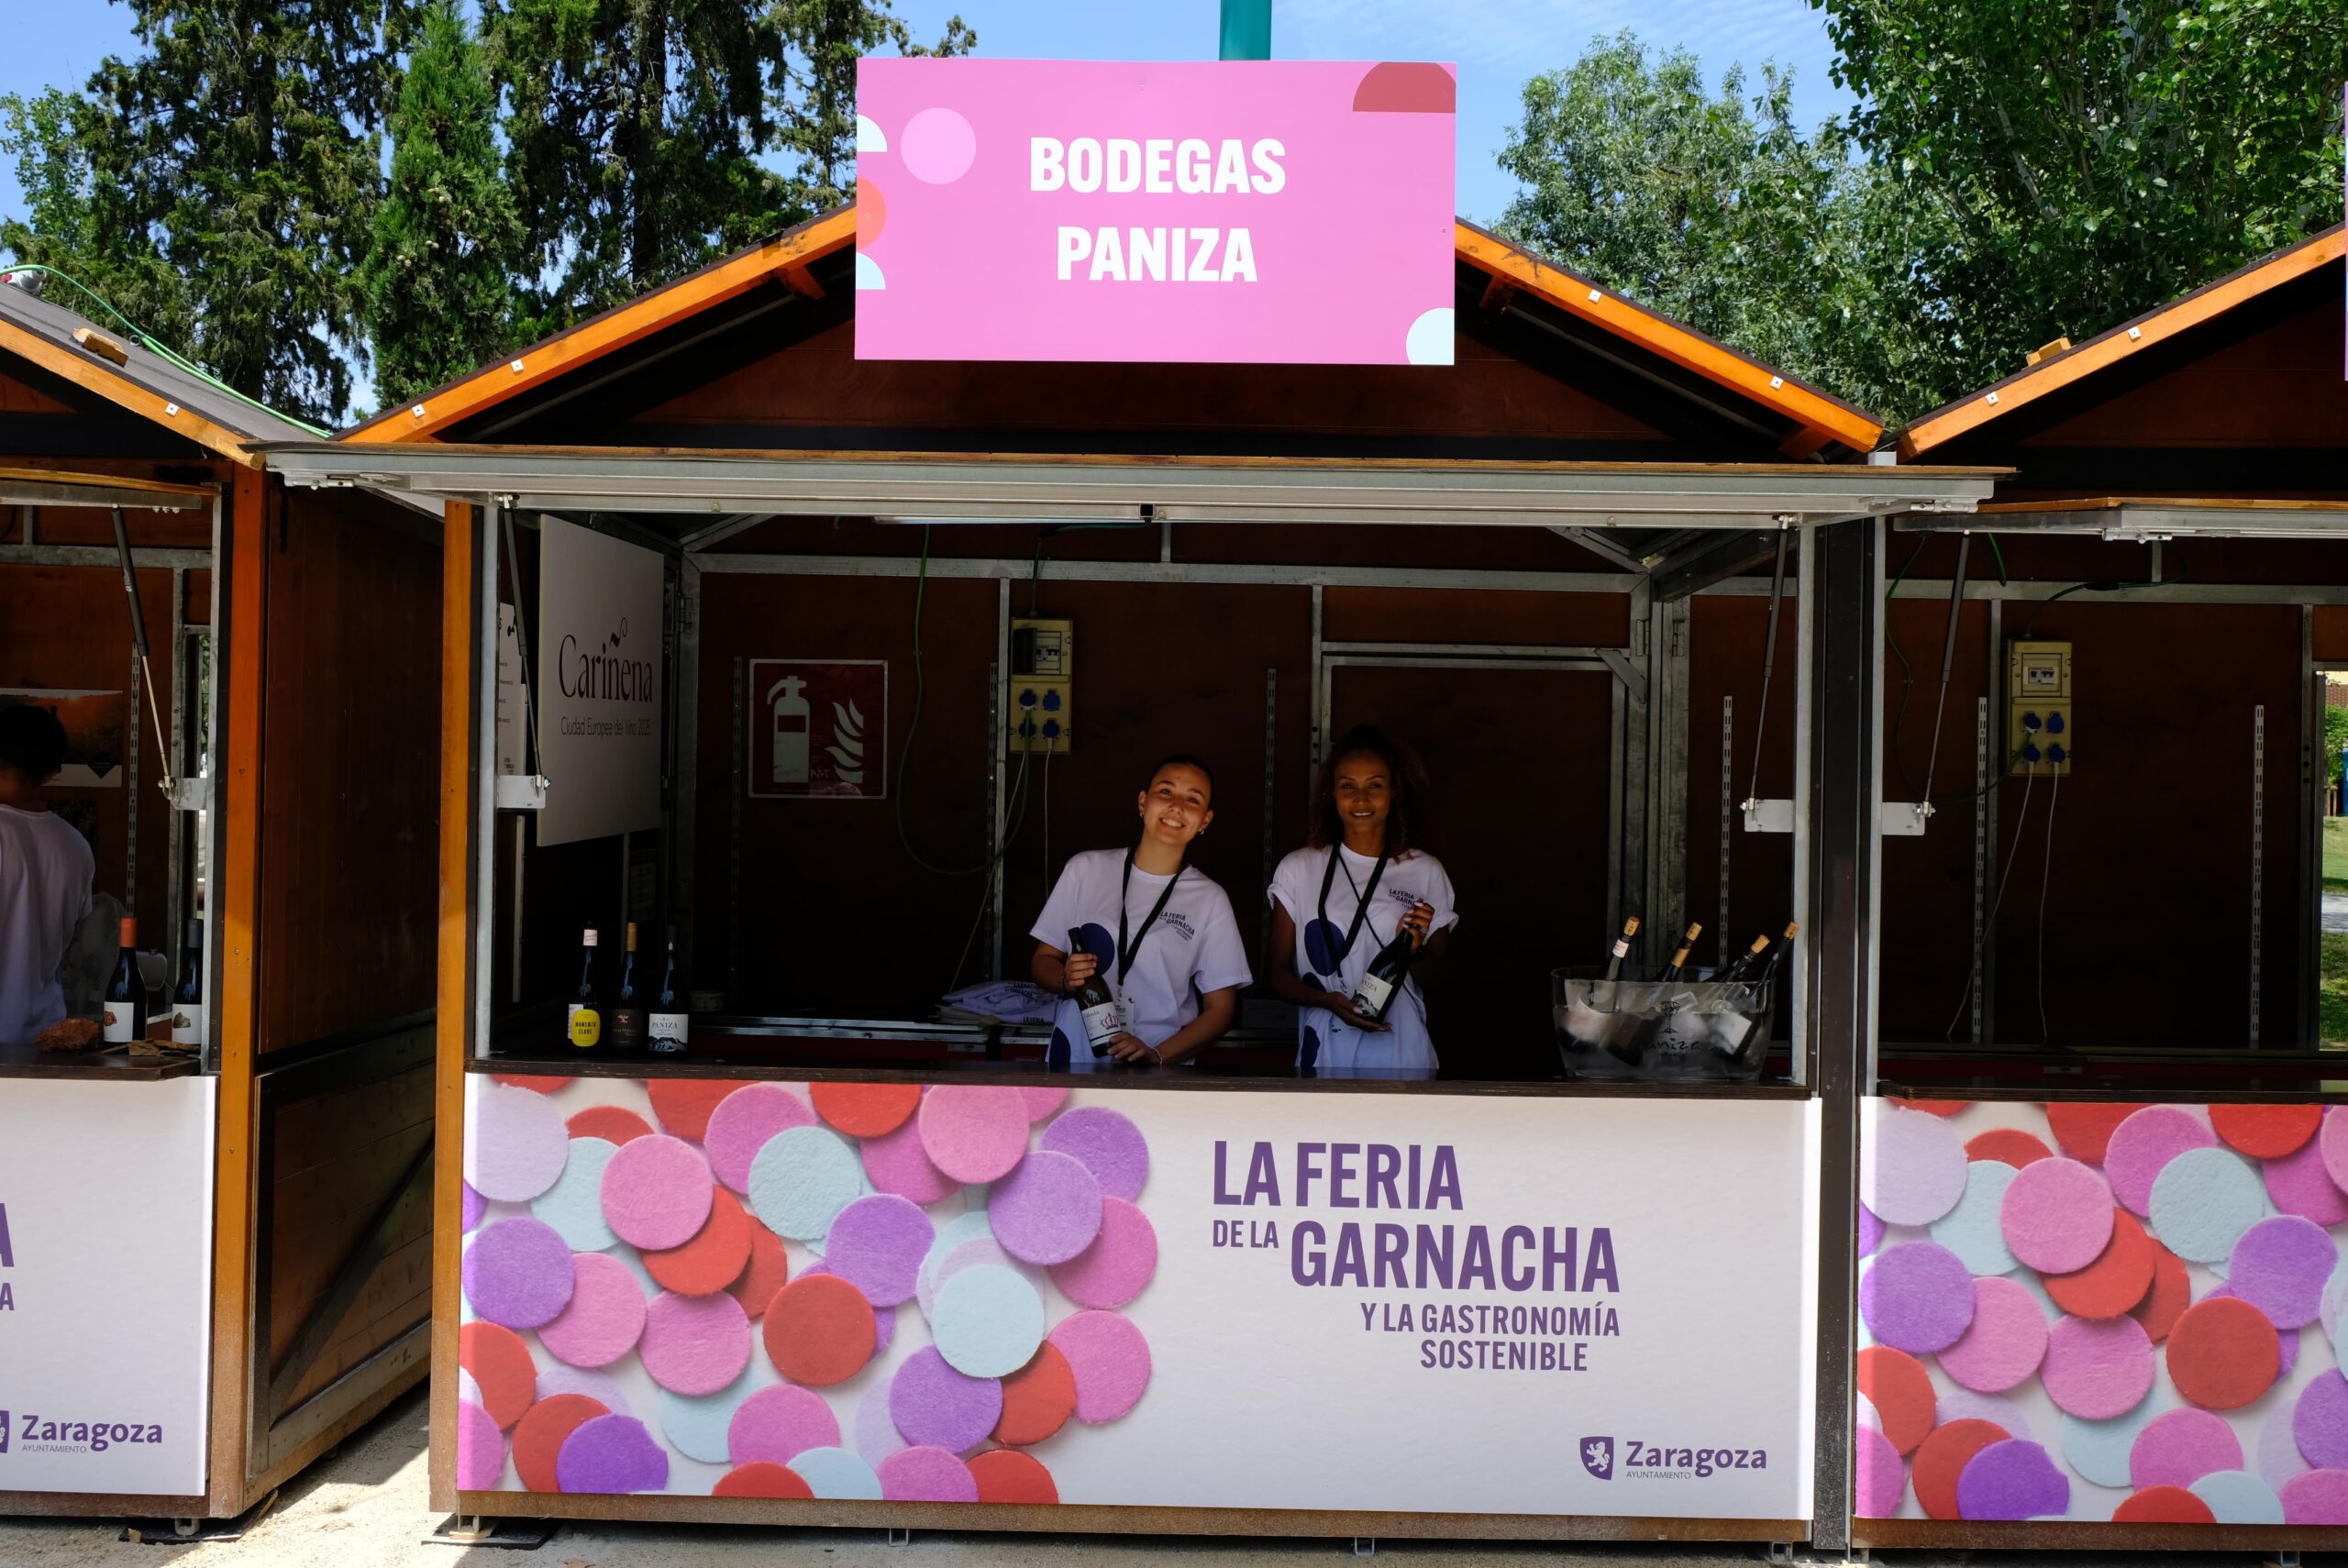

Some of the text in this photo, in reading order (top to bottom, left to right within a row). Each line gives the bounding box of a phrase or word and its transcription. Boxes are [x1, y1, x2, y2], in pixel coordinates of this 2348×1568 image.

[1030, 137, 1286, 194] BODEGAS
[1058, 226, 1258, 282] PANIZA
[559, 616, 653, 702] Cariñena
[560, 716, 585, 735] Ciudad
[587, 717, 613, 737] Europea
[614, 719, 624, 735] del
[625, 719, 637, 735] Vino
[1213, 1140, 1464, 1210] LA FERIA
[1213, 1220, 1620, 1293] DE LA GARNACHA
[1360, 1301, 1620, 1337] Y LA GASTRONOMÍA
[1420, 1339, 1588, 1372] SOSTENIBLE
[21, 1414, 162, 1452] Zaragoza
[21, 1444, 87, 1453] AYUNTAMIENTO
[1625, 1441, 1767, 1478] Zaragoza
[1625, 1470, 1691, 1479] AYUNTAMIENTO
